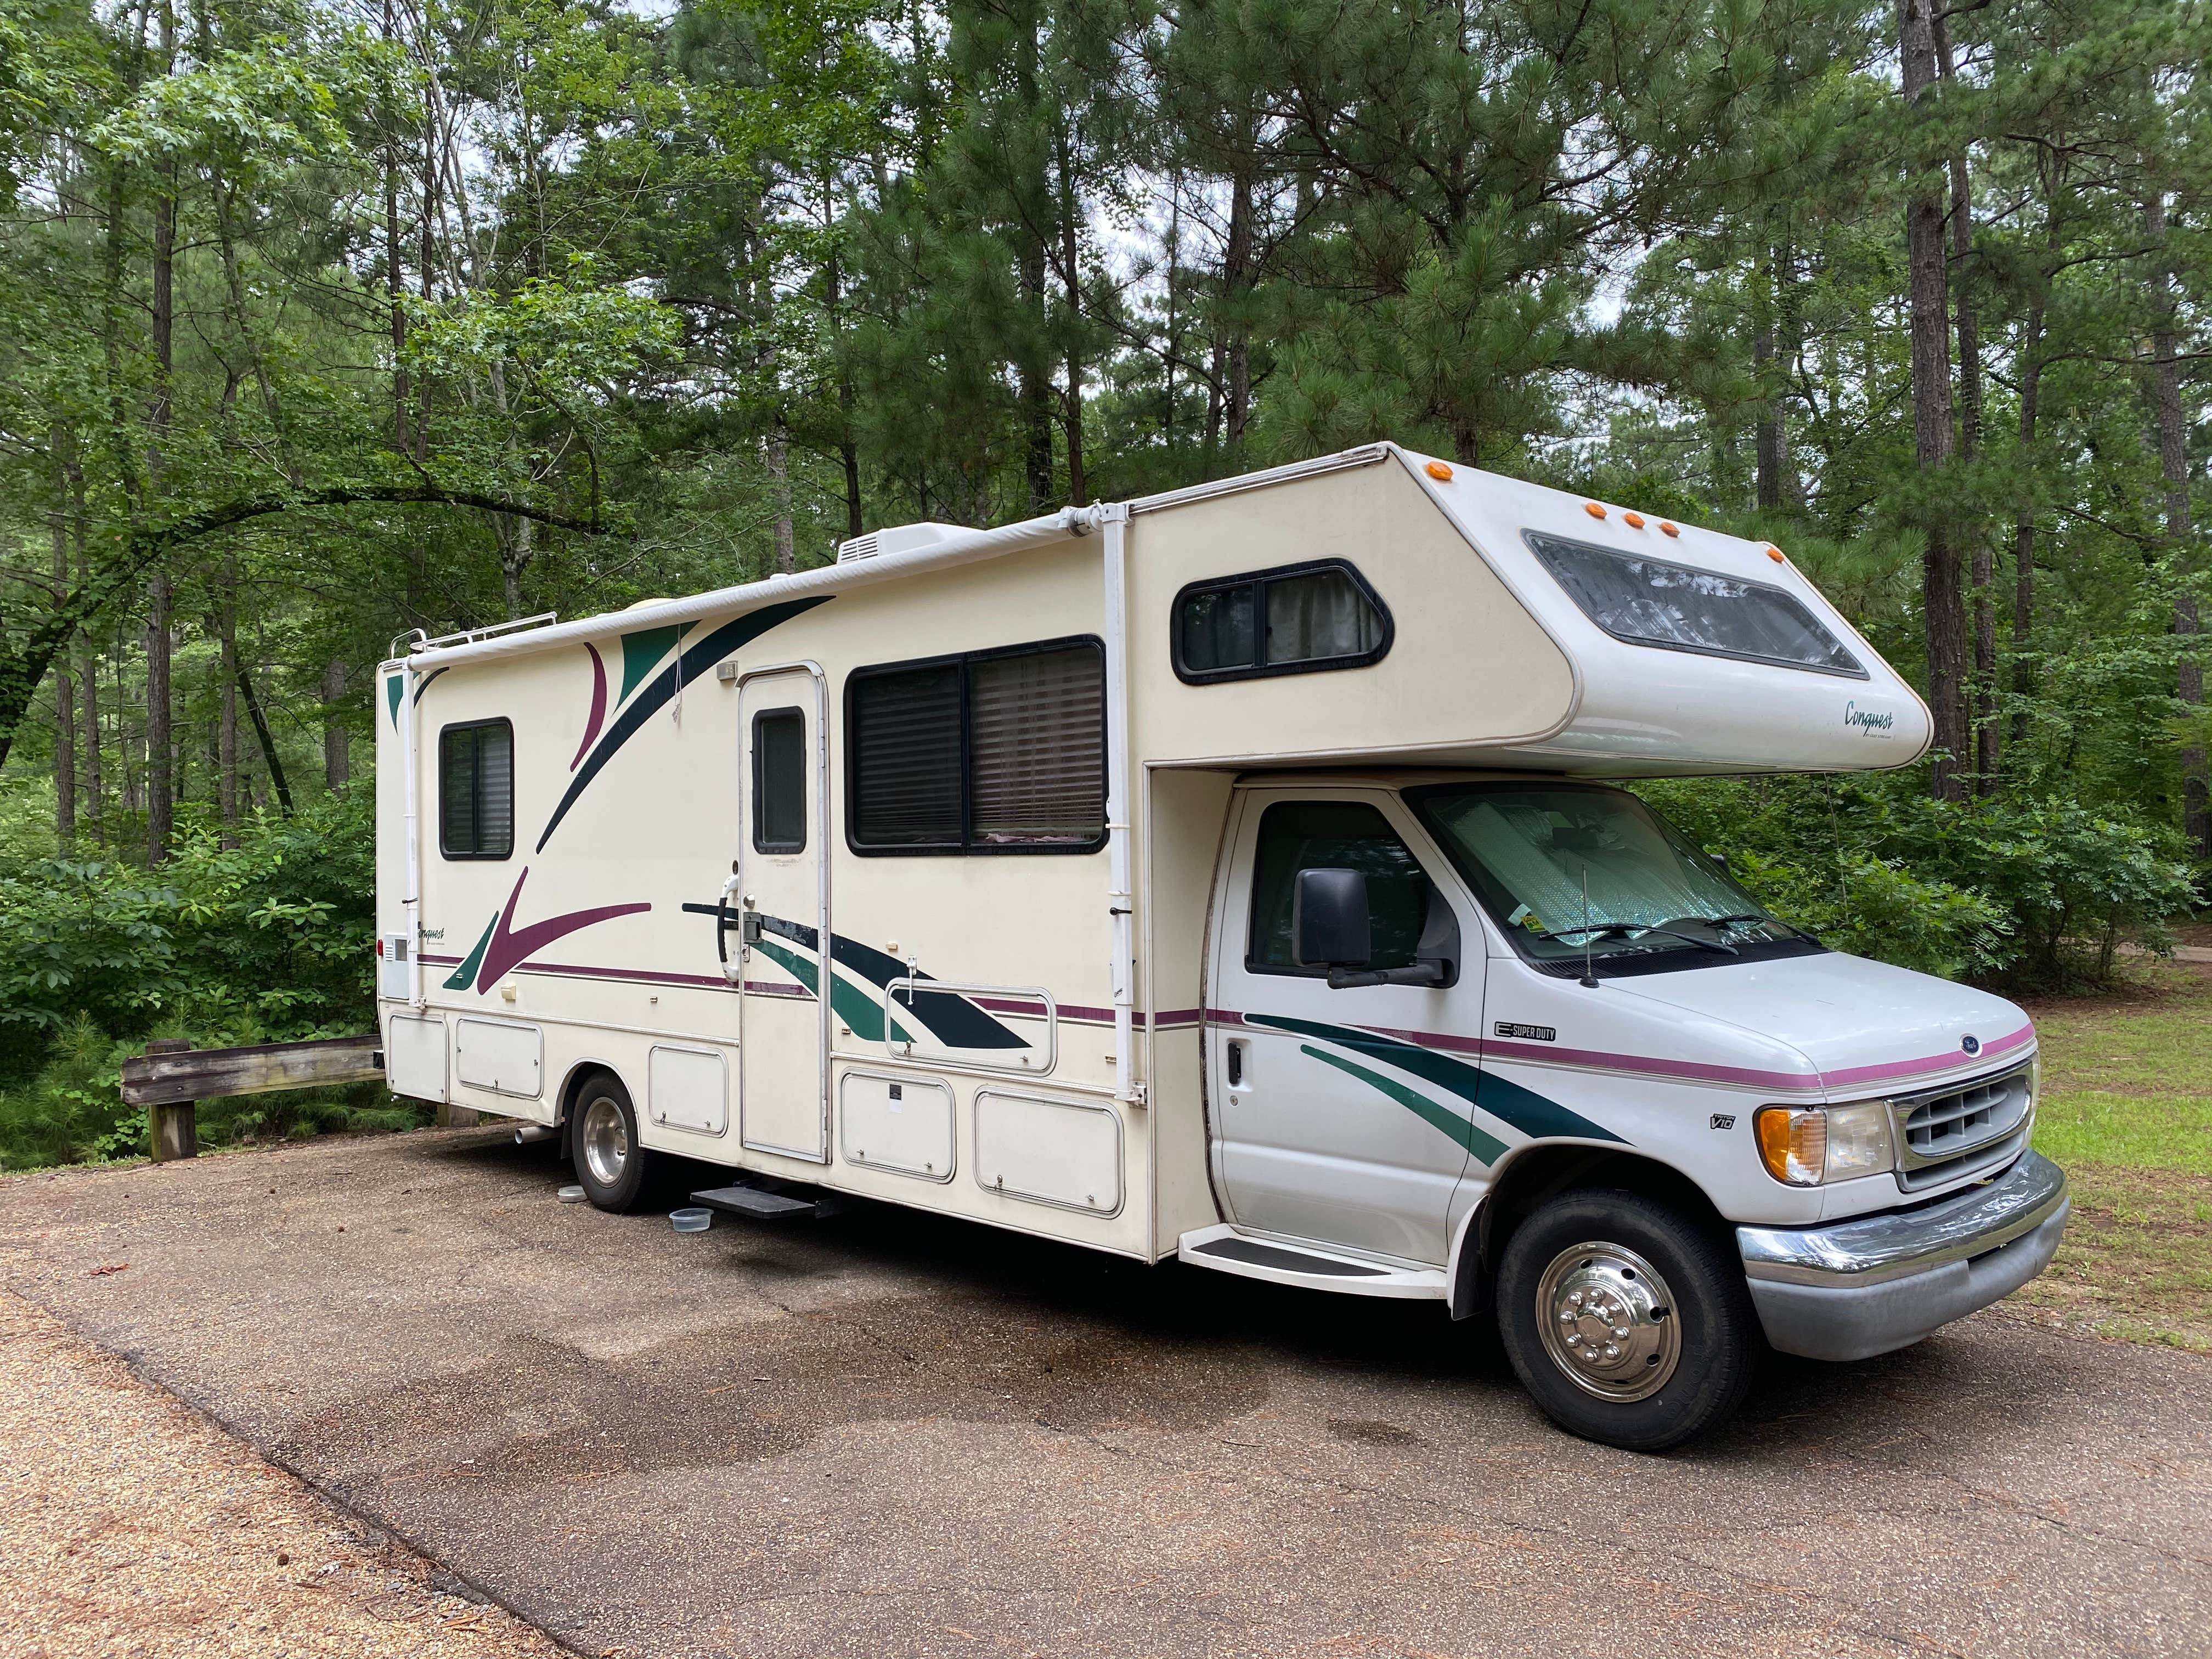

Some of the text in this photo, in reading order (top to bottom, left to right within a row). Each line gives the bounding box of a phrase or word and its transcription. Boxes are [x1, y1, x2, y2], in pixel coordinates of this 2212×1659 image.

[1845, 700, 1893, 737] Conquest
[419, 927, 444, 945] onquest
[1536, 1028, 1555, 1040] DUTY
[1711, 1118, 1733, 1128] V10
